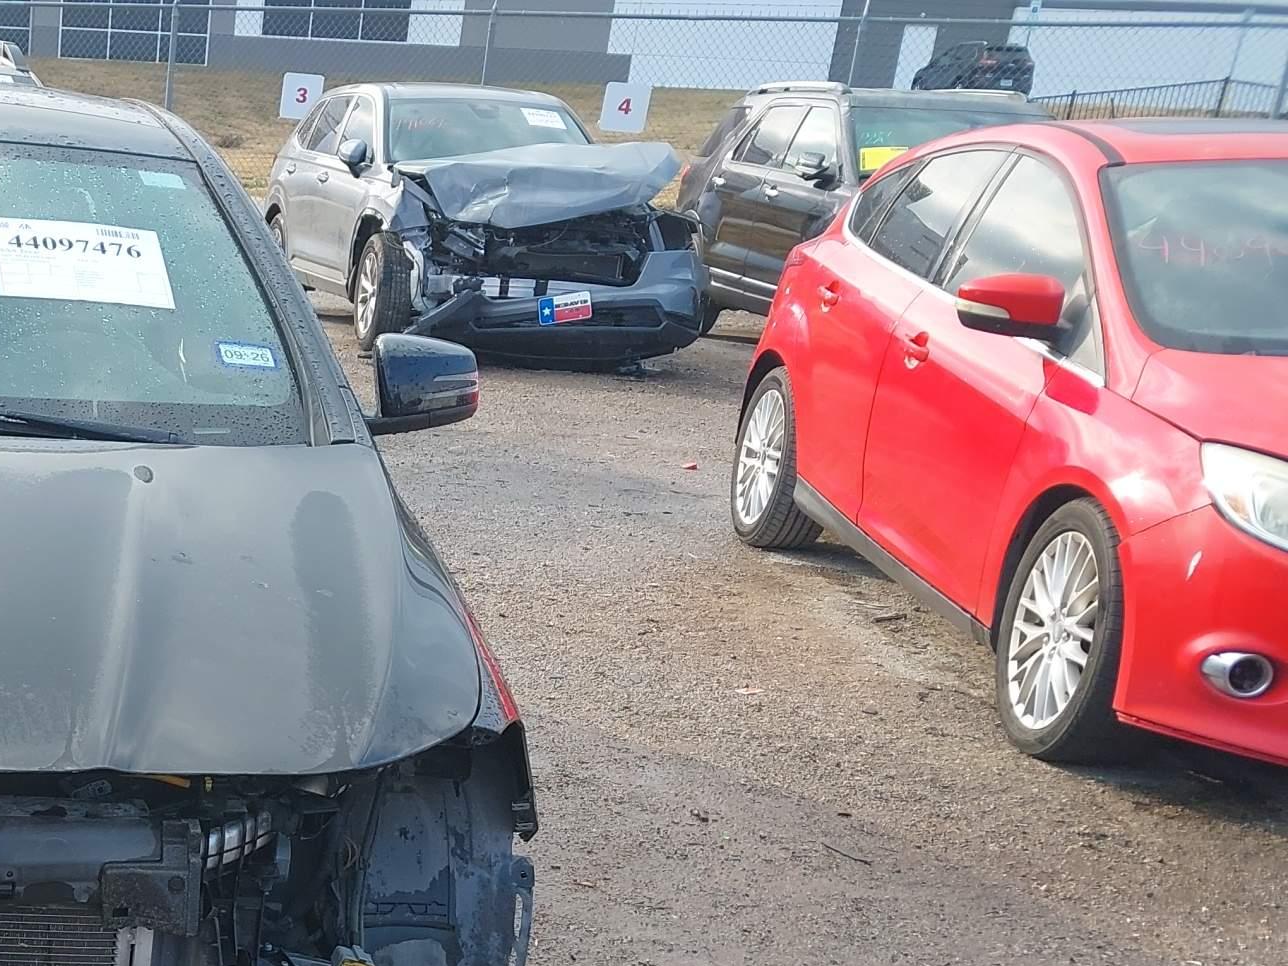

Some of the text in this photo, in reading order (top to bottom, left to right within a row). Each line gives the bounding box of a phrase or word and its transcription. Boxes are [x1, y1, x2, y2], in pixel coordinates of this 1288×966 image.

[295, 87, 308, 104] 3
[617, 98, 632, 115] 4
[7, 234, 142, 259] 44097476
